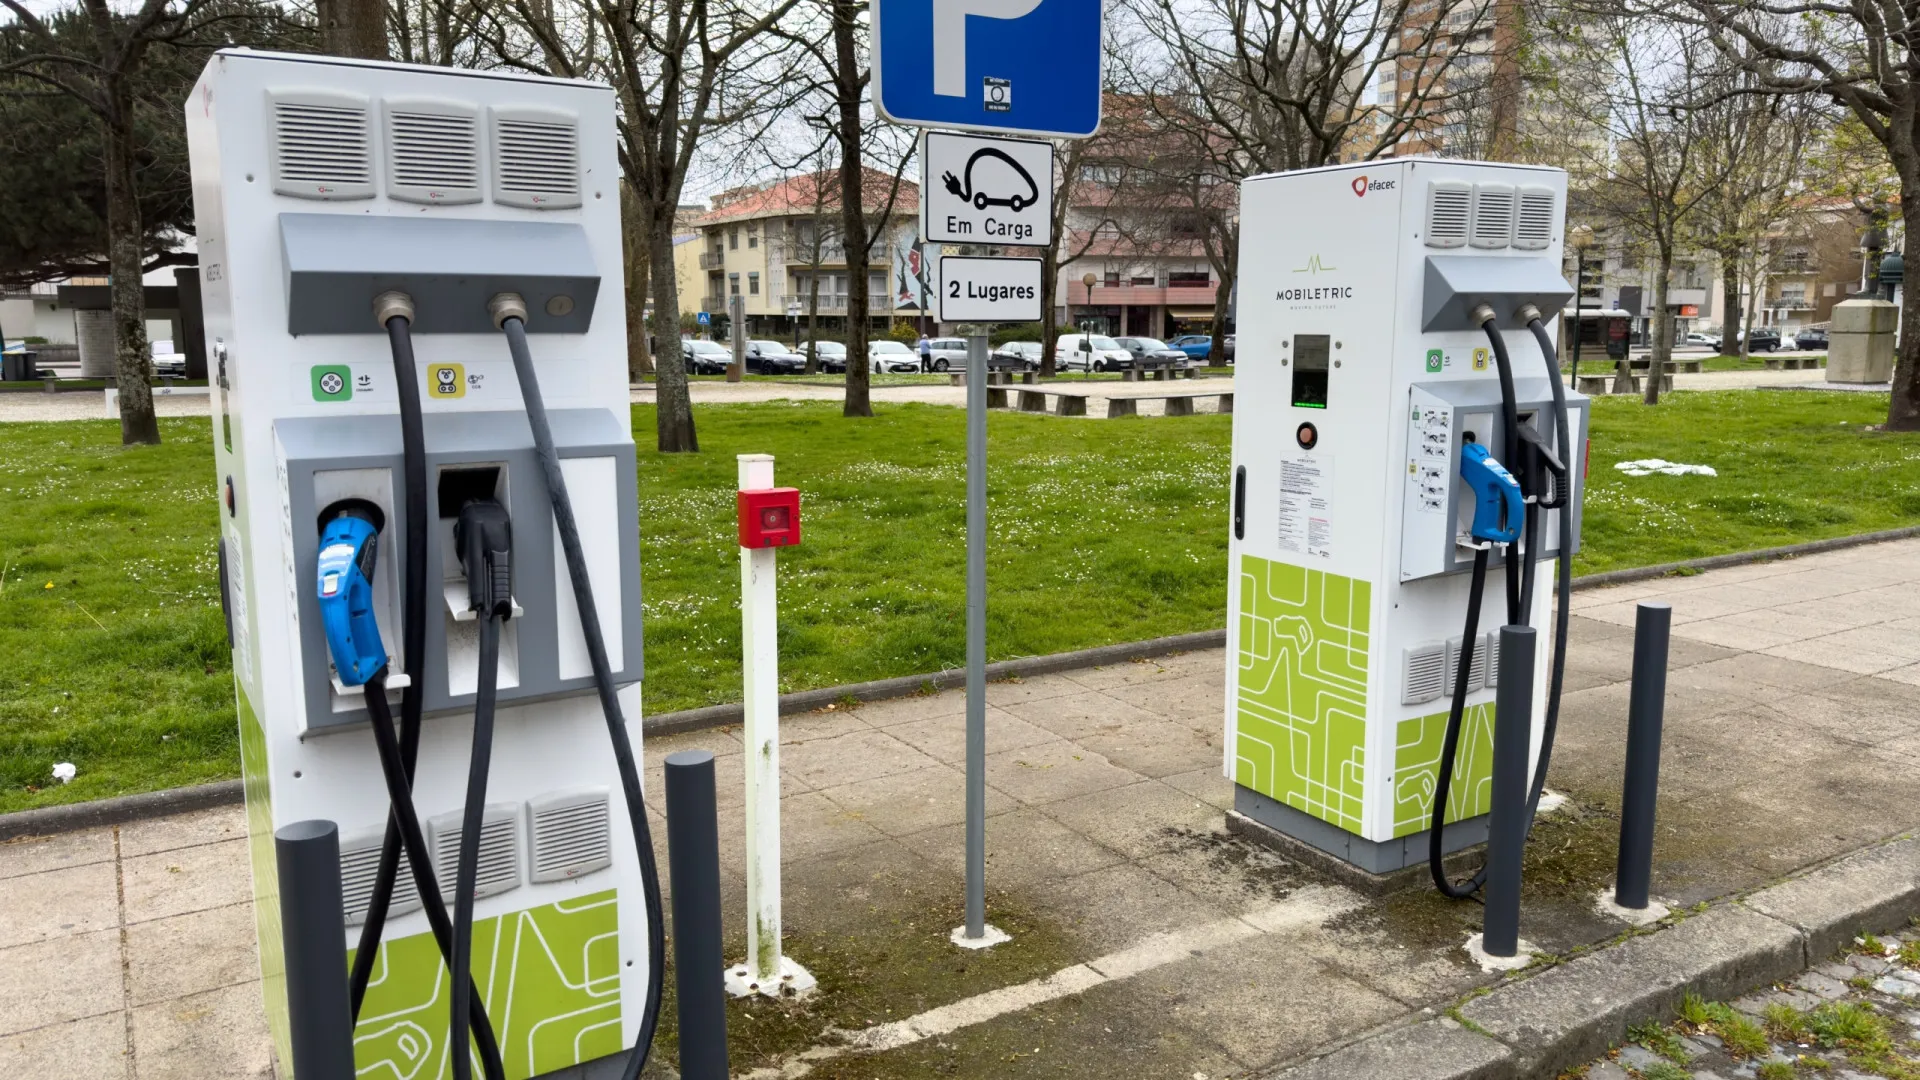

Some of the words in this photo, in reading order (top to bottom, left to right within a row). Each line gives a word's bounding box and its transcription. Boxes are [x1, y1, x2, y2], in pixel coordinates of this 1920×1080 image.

[1368, 179, 1396, 191] efacec
[947, 216, 972, 234] Em
[984, 217, 1033, 240] Carga
[949, 280, 961, 298] 2
[968, 280, 1035, 302] Lugares
[1276, 286, 1352, 301] MOBILETRIC
